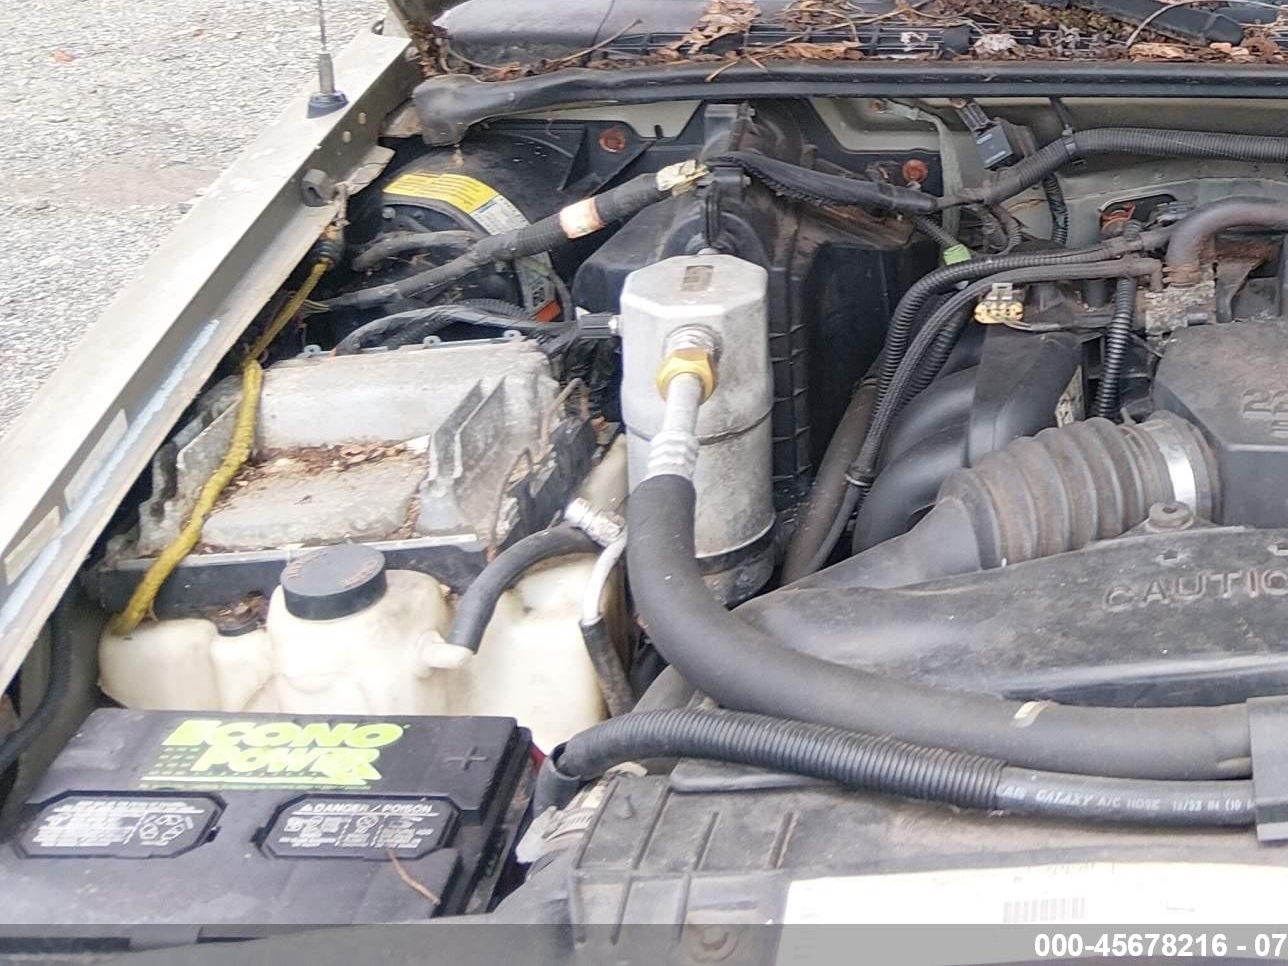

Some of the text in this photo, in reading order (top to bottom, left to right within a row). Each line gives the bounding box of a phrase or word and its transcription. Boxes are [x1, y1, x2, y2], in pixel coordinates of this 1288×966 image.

[161, 719, 404, 748] ECONO
[190, 744, 383, 781] POWER
[1034, 790, 1094, 808] GALAXY
[1096, 796, 1122, 809] A/C
